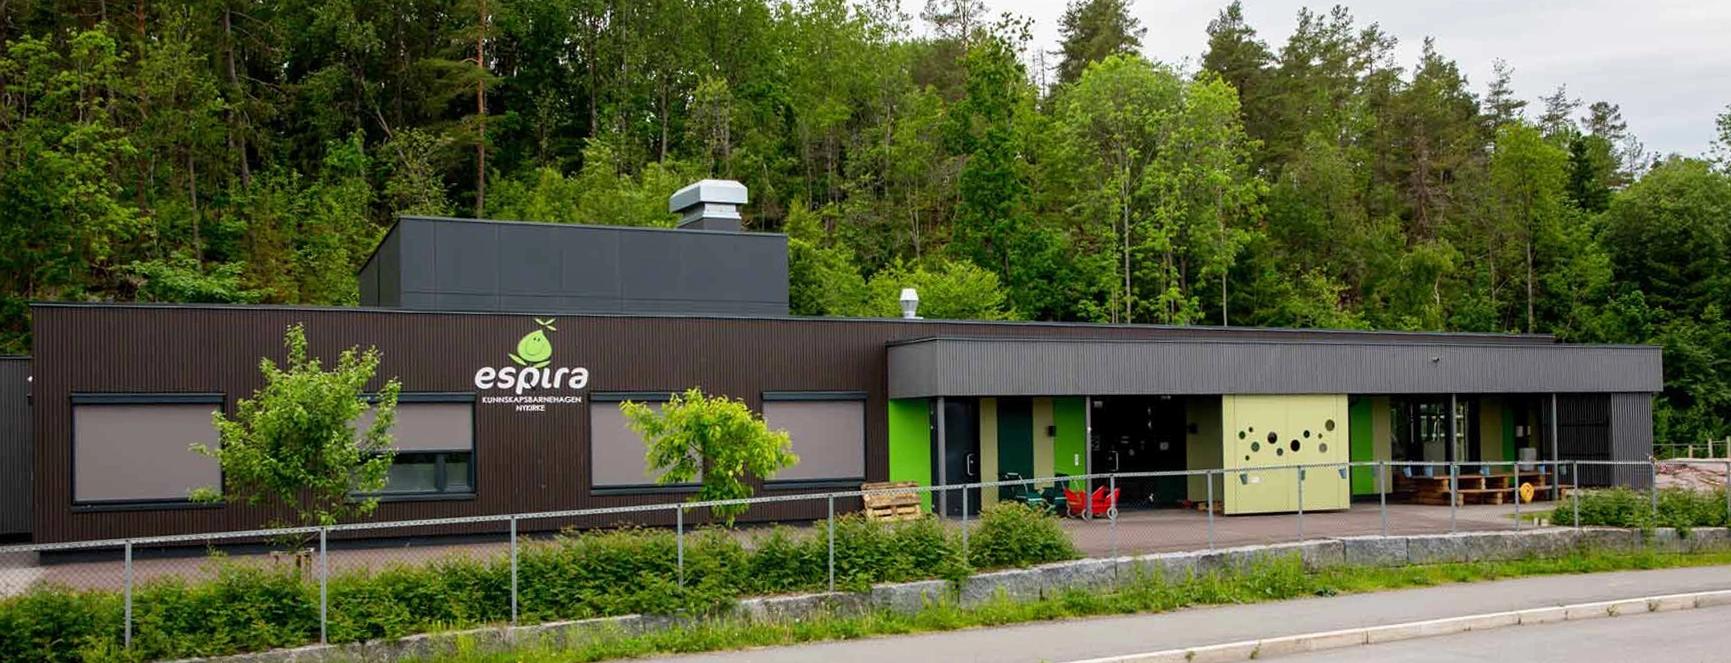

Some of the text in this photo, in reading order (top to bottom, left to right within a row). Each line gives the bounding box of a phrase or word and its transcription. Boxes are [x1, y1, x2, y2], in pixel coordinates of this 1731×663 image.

[474, 366, 589, 395] espira
[482, 396, 582, 404] KUNNSKAPSBARNEHAGEN
[516, 404, 546, 412] NYKIRKE
